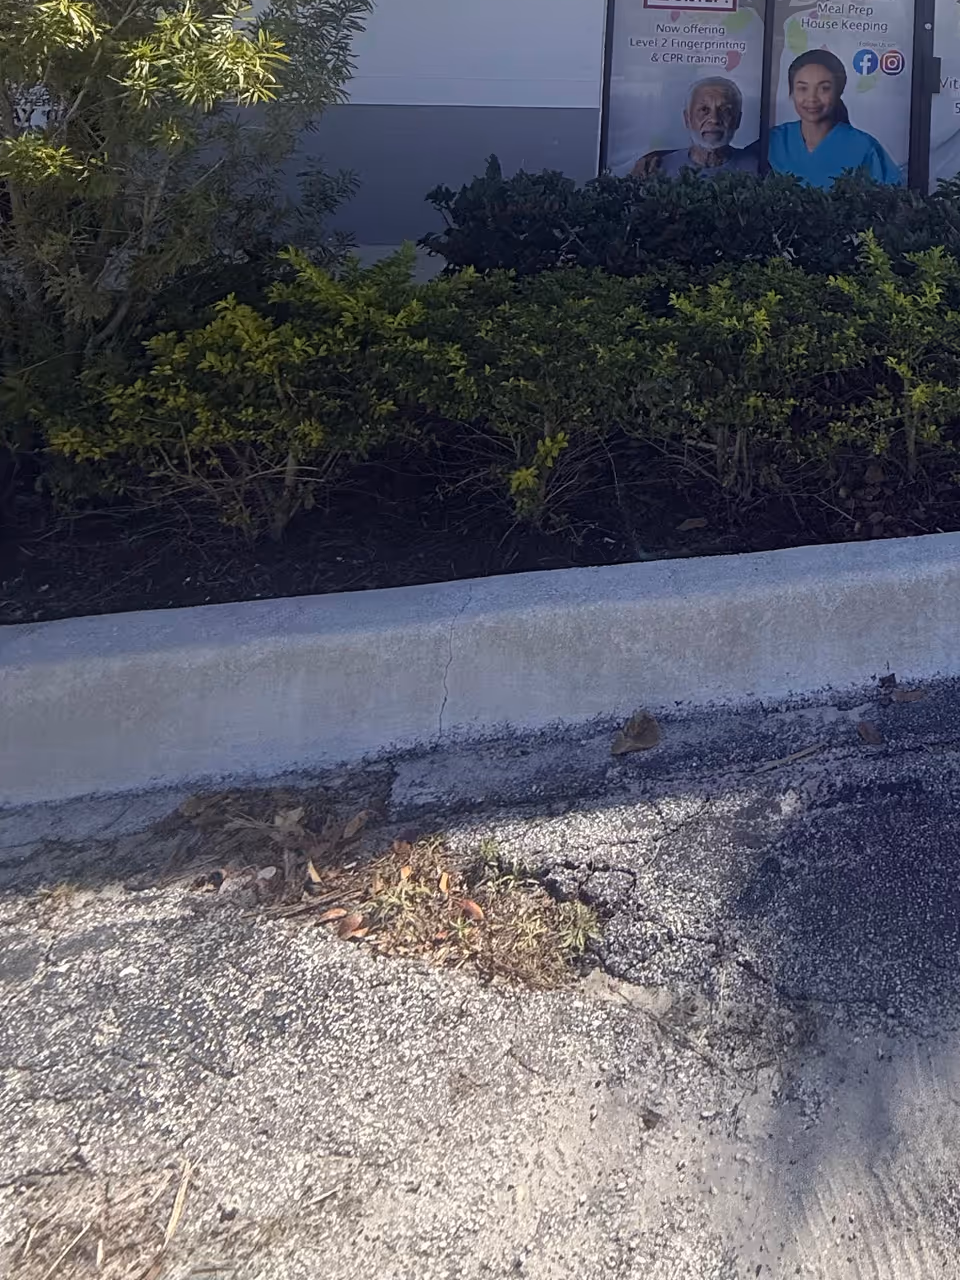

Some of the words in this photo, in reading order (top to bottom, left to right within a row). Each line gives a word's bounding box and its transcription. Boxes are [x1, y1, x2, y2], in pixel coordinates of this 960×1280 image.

[817, 3, 844, 15] Meal
[848, 4, 874, 17] Prep
[656, 23, 681, 34] Now
[682, 24, 726, 37] offering
[801, 18, 839, 30] House
[841, 19, 889, 34] Keeping
[629, 37, 658, 48] Level
[660, 38, 668, 48] 2
[670, 39, 747, 52] Fingerprinting
[650, 52, 660, 63] &
[662, 52, 684, 63] CPR
[686, 54, 728, 66] training
